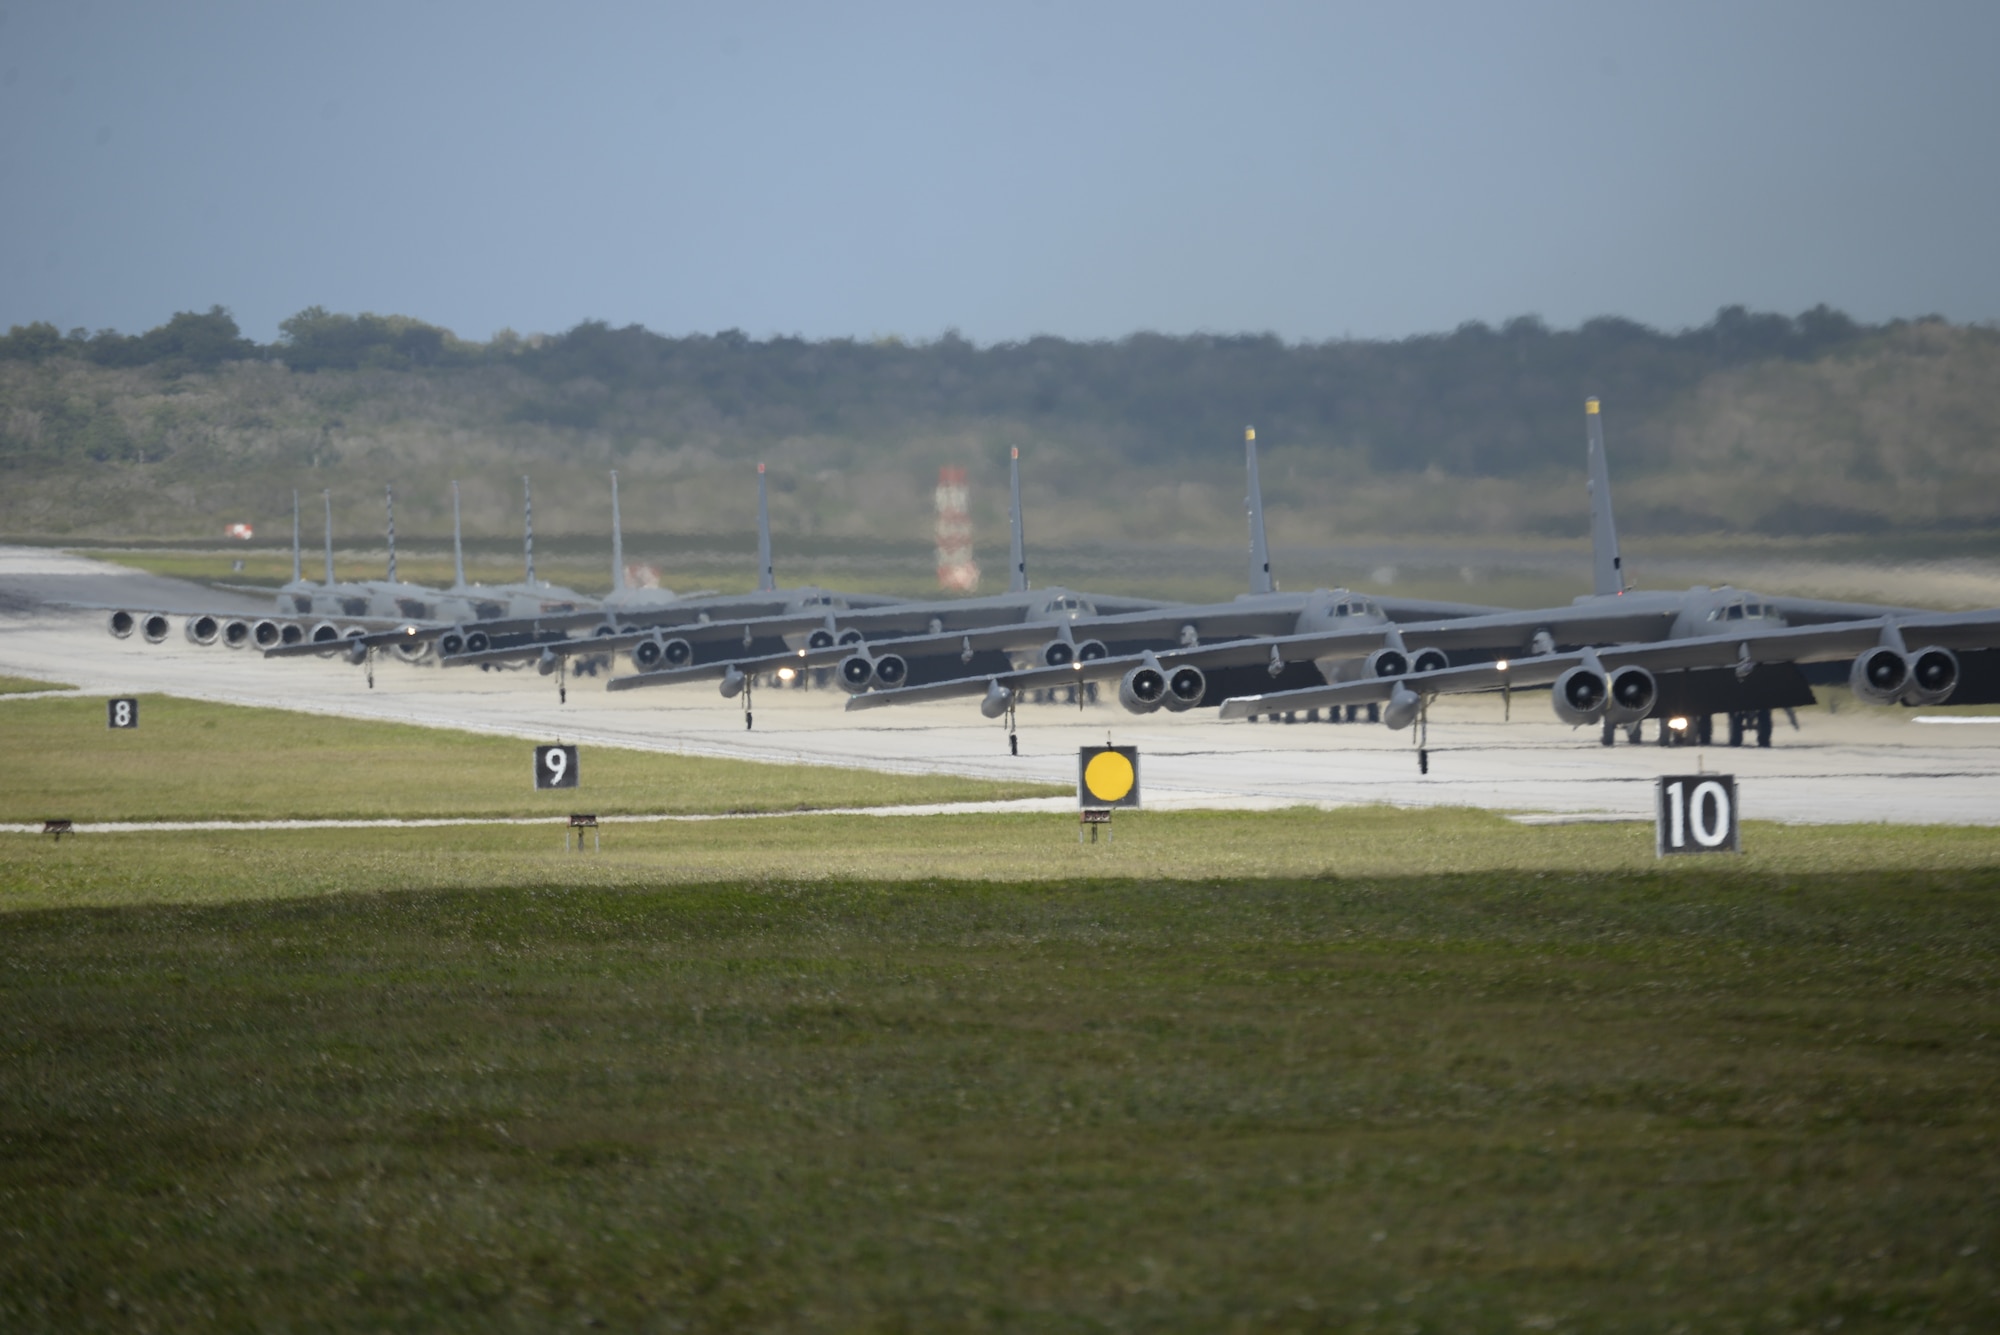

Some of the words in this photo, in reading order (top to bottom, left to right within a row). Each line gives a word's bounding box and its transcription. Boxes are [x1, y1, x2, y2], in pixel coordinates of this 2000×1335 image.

[115, 701, 131, 726] 8
[545, 748, 567, 786] 9
[1666, 781, 1730, 847] 10
